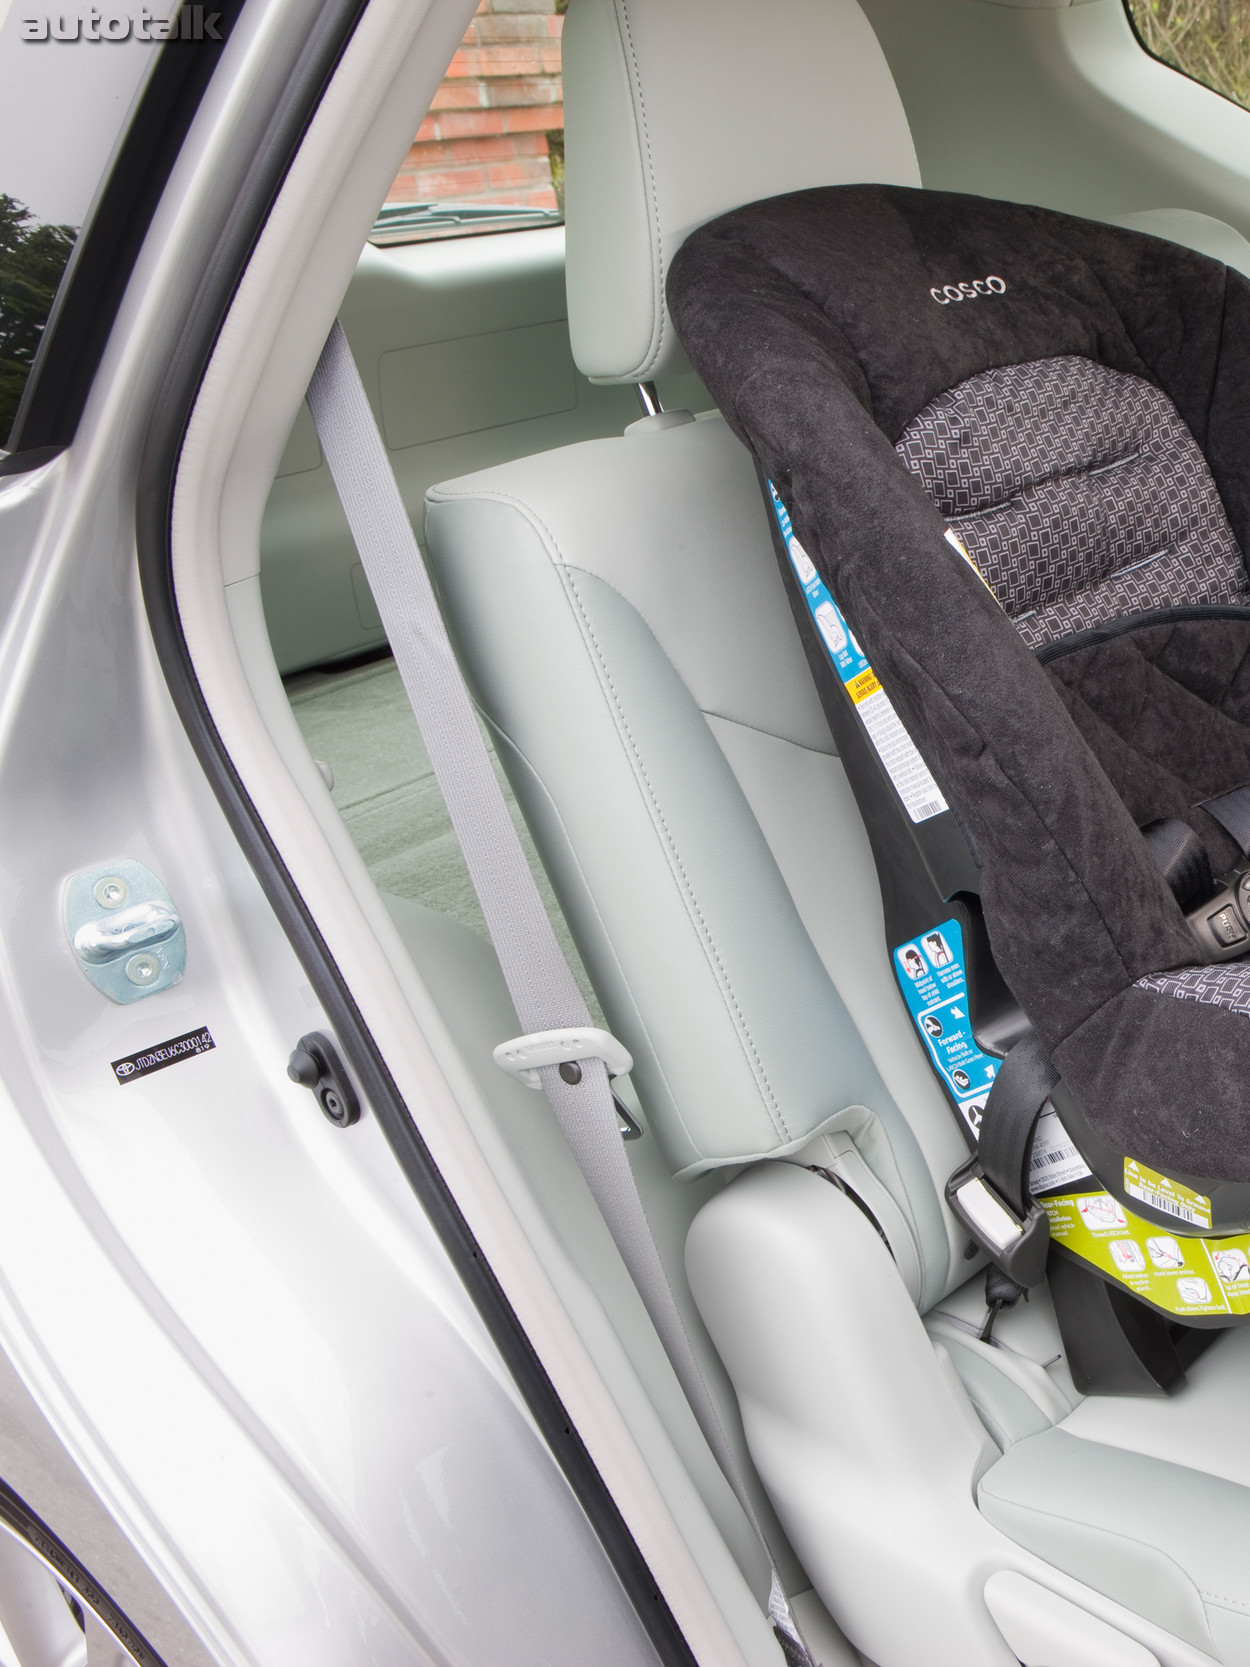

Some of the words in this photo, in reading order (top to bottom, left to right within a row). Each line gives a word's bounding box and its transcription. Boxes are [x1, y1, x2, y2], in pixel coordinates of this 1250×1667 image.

[135, 1031, 213, 1071] JTDZN3EU6C3000142
[937, 1029, 964, 1047] Forward
[946, 1041, 968, 1055] Facing
[1124, 1168, 1138, 1180] Line
[1139, 1175, 1146, 1183] to
[1147, 1180, 1156, 1188] be
[1157, 1185, 1175, 1197] Level
[1185, 1198, 1210, 1214] Ground
[1138, 1181, 1179, 1206] Rear-Facing
[1180, 1202, 1195, 1213] Only
